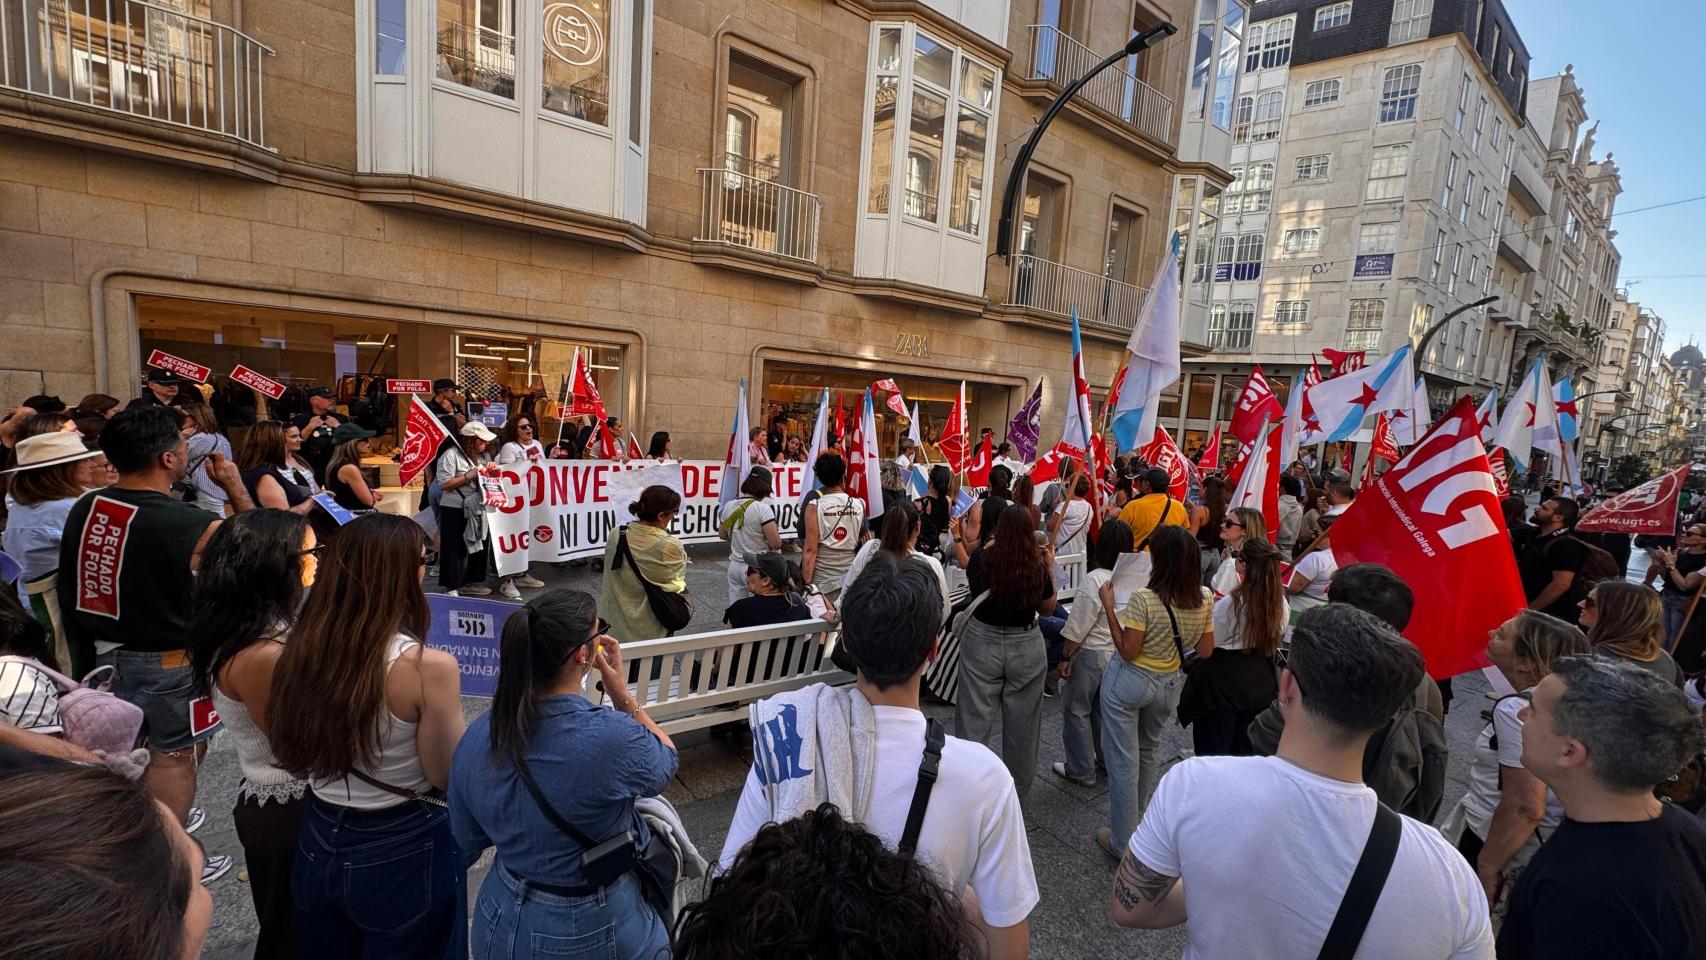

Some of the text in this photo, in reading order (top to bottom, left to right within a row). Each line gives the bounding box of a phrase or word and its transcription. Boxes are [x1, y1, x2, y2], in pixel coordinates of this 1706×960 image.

[156, 359, 200, 379] POR FOLGA
[163, 356, 198, 372] PECHADO
[238, 374, 276, 396] POR FOLGA
[244, 371, 275, 388] PECHADO
[559, 512, 578, 550] NI
[1413, 526, 1436, 557] Galega
[84, 512, 109, 600] POR FOLGA
[100, 525, 121, 596] PECHADO
[472, 647, 489, 658] EN
